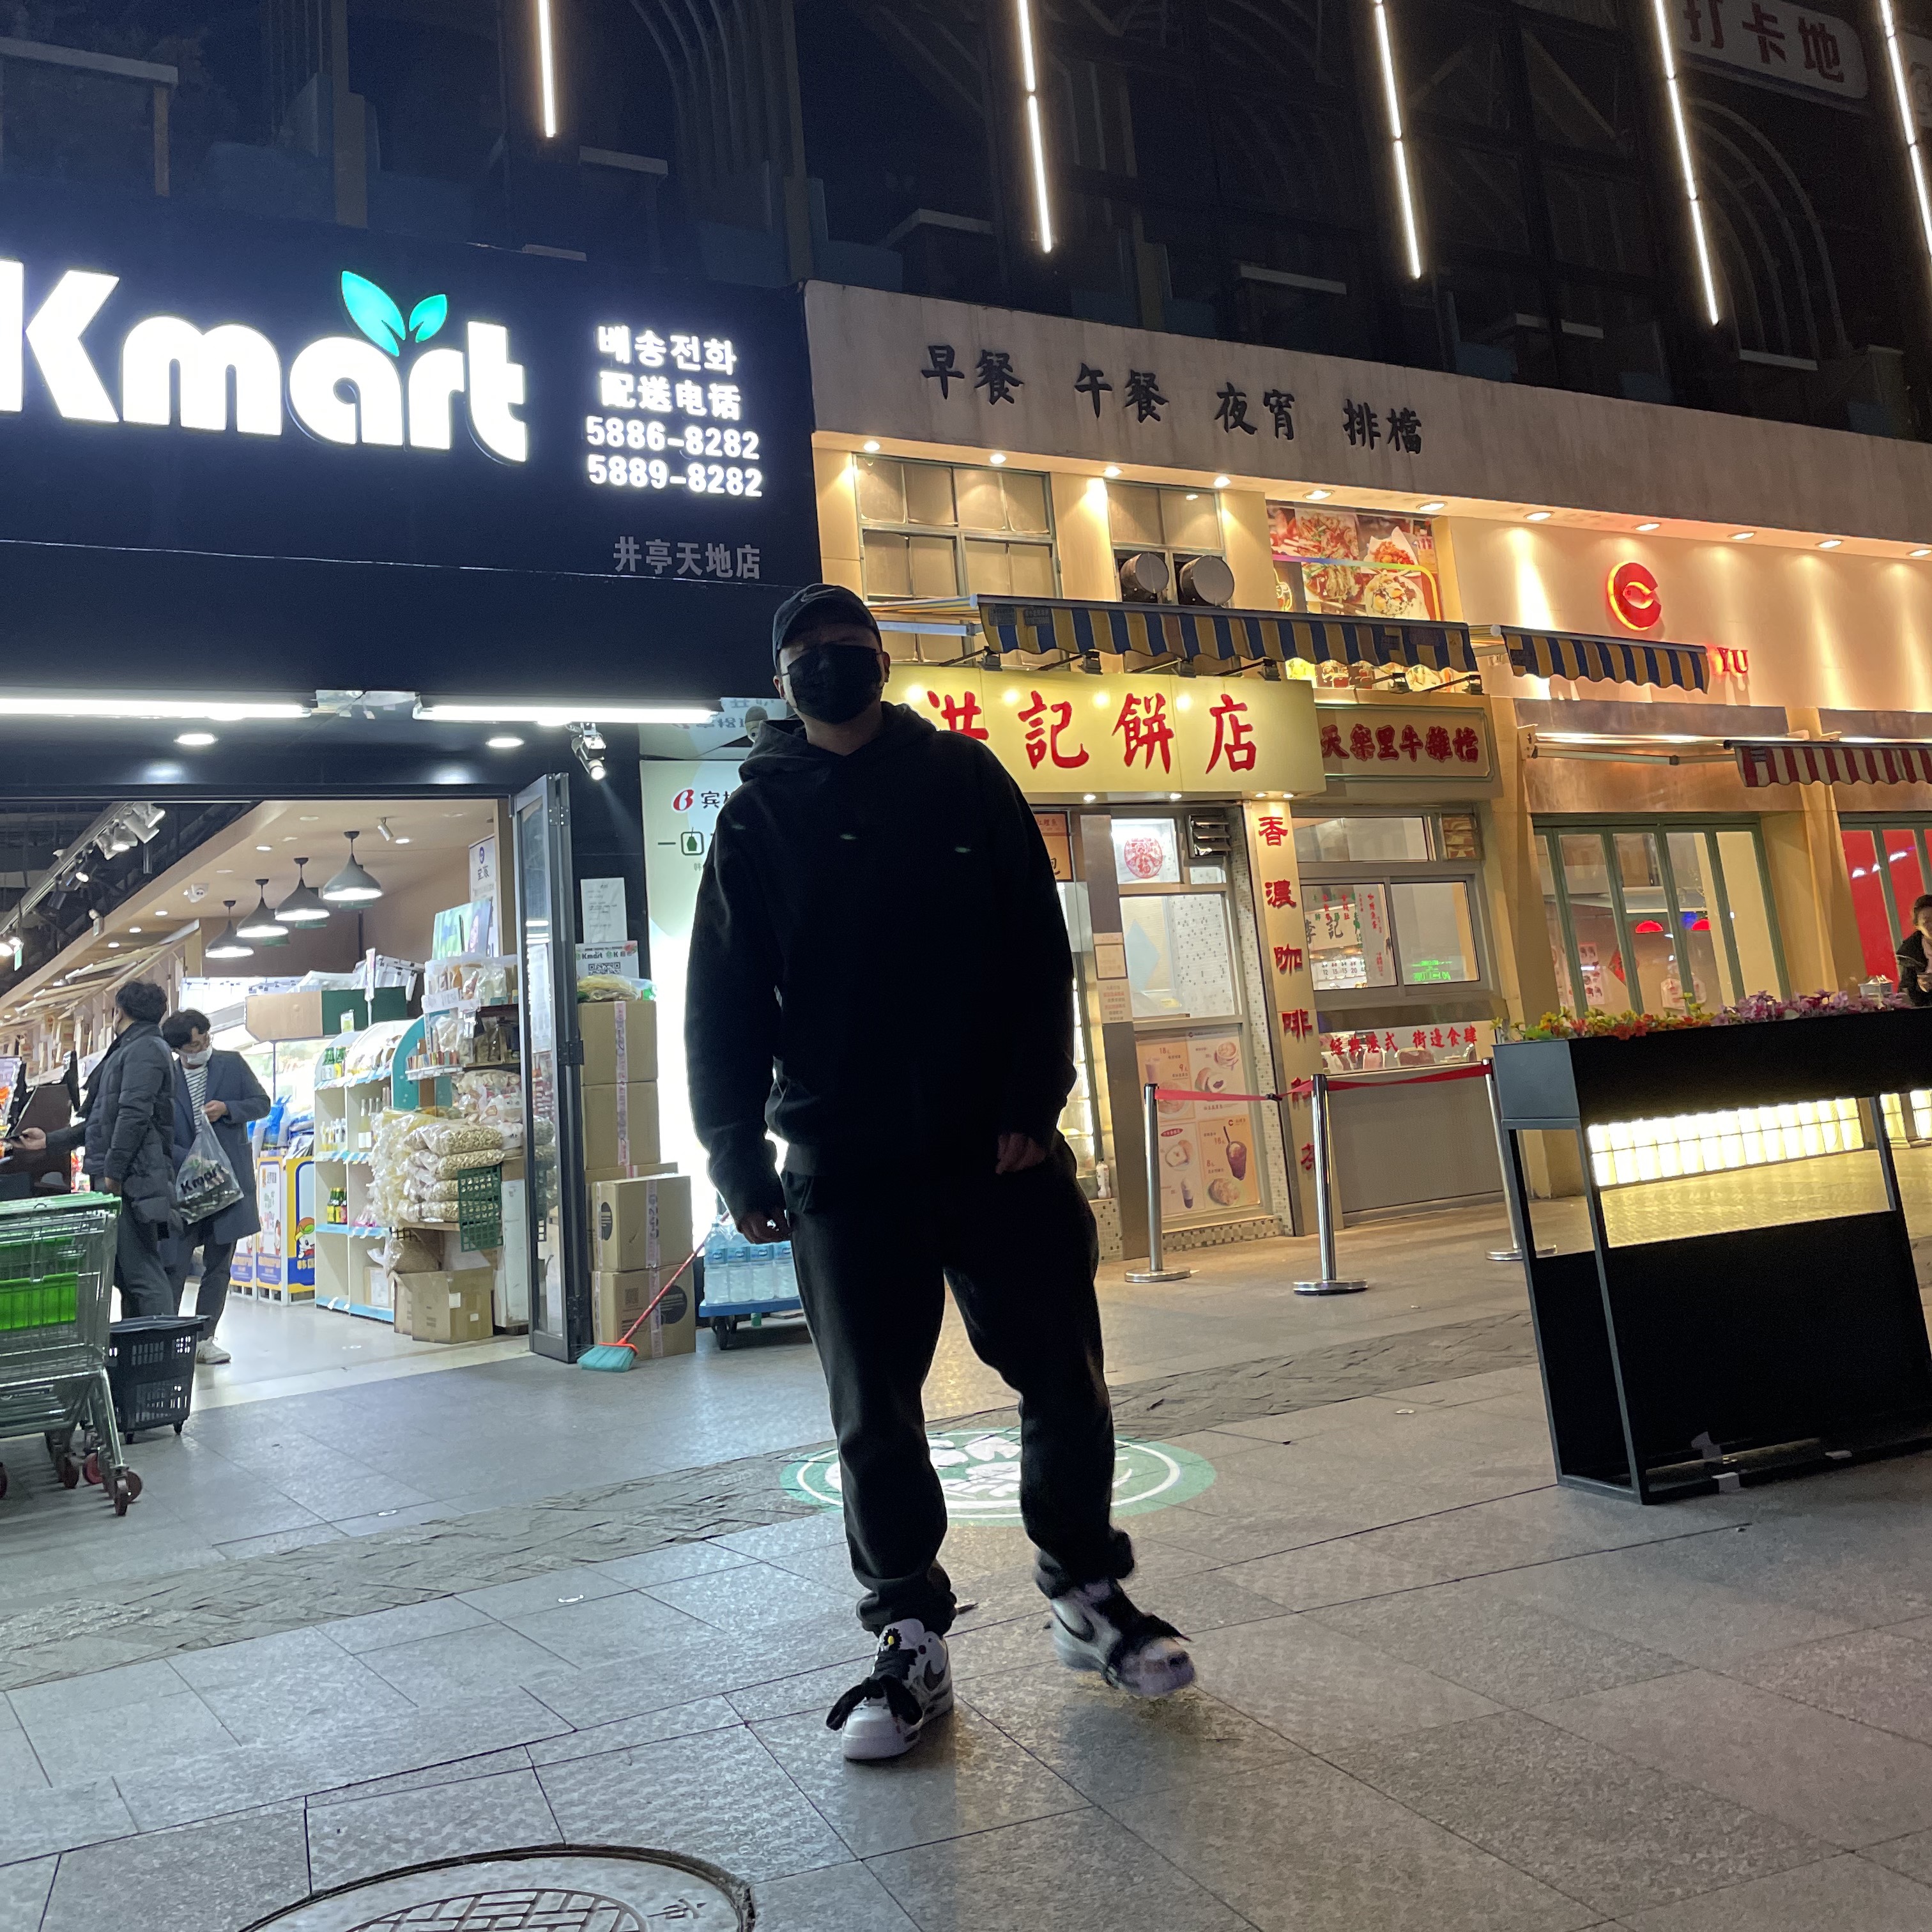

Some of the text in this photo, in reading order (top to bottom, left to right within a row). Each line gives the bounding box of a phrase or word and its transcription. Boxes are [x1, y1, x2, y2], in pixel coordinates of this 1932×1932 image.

[0, 260, 526, 463] Kmart
[597, 325, 737, 375] 배송전화
[599, 371, 741, 420] 配送电话
[921, 344, 1023, 405] 早餐
[1074, 362, 1169, 424] 午餐
[1216, 382, 1295, 441] 夜宵
[586, 415, 760, 460] 5886-8282
[587, 454, 763, 497] 5889-8282
[613, 535, 760, 579] 井亭天地店
